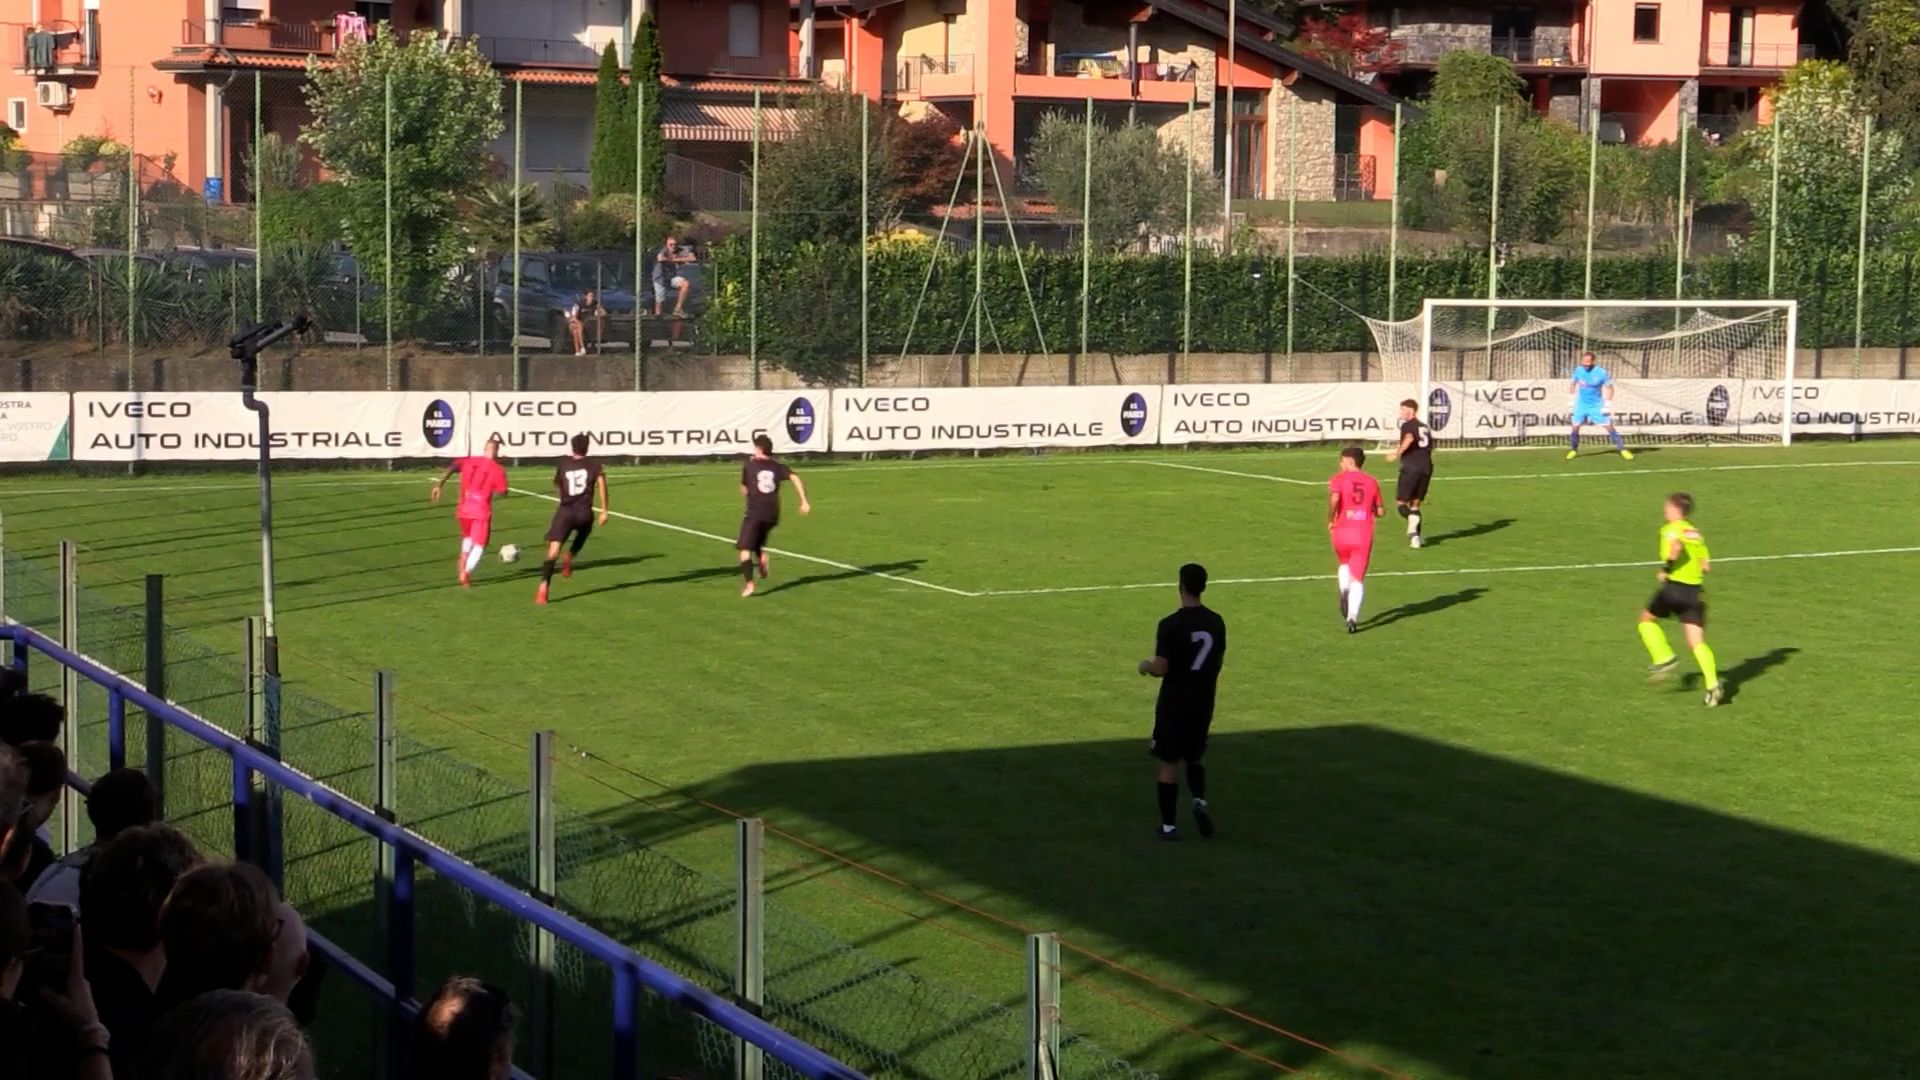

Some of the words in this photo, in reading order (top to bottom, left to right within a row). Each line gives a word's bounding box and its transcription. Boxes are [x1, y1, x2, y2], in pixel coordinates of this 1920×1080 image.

[1173, 392, 1251, 407] IVECO
[1475, 386, 1546, 403] IVECO
[88, 401, 192, 418] IVECO
[485, 401, 577, 417] IVECO
[845, 396, 930, 413] IVECO
[1174, 419, 1243, 434] AUTO
[1475, 413, 1540, 429] AUTO
[1752, 411, 1811, 425] AUO
[1817, 411, 1920, 425] INDUSTRI
[489, 431, 568, 447] AUTO
[847, 425, 921, 441] AUTO
[931, 421, 1104, 440] INDUSTRIALE
[1417, 426, 1430, 448] 5
[88, 432, 182, 450] AUTO
[193, 431, 402, 450] INDUSTRIALE
[565, 468, 588, 496] 13
[757, 470, 776, 494] 8
[1351, 481, 1365, 505] 5
[1190, 630, 1214, 671] 7
